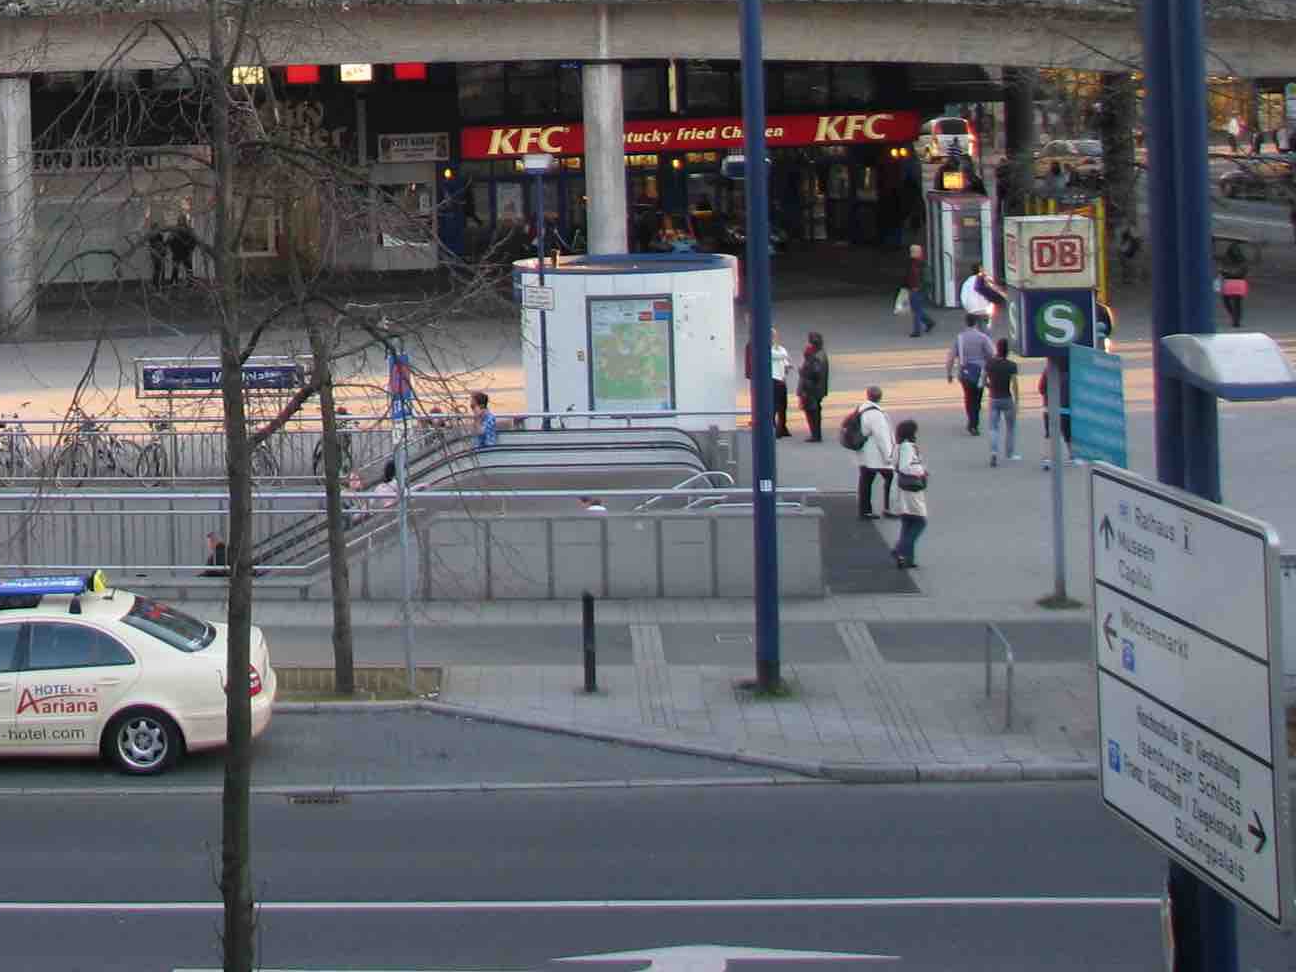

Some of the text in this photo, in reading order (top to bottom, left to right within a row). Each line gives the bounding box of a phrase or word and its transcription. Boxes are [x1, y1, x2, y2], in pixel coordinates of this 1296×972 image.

[487, 126, 569, 155] KFC
[676, 126, 715, 140] Fried
[720, 125, 784, 140] Chen
[815, 114, 895, 141] KFC
[1037, 242, 1079, 267] DB
[1043, 304, 1075, 344] S
[1135, 506, 1176, 543] Rathaus
[1117, 528, 1156, 563] Museen
[1119, 608, 1190, 661] Wochenmarkt
[16, 688, 98, 715] Aariana
[34, 684, 73, 695] HOTEL
[1138, 732, 1242, 817] Isenburger Schloss
[1174, 816, 1247, 883] Büsingpalais
